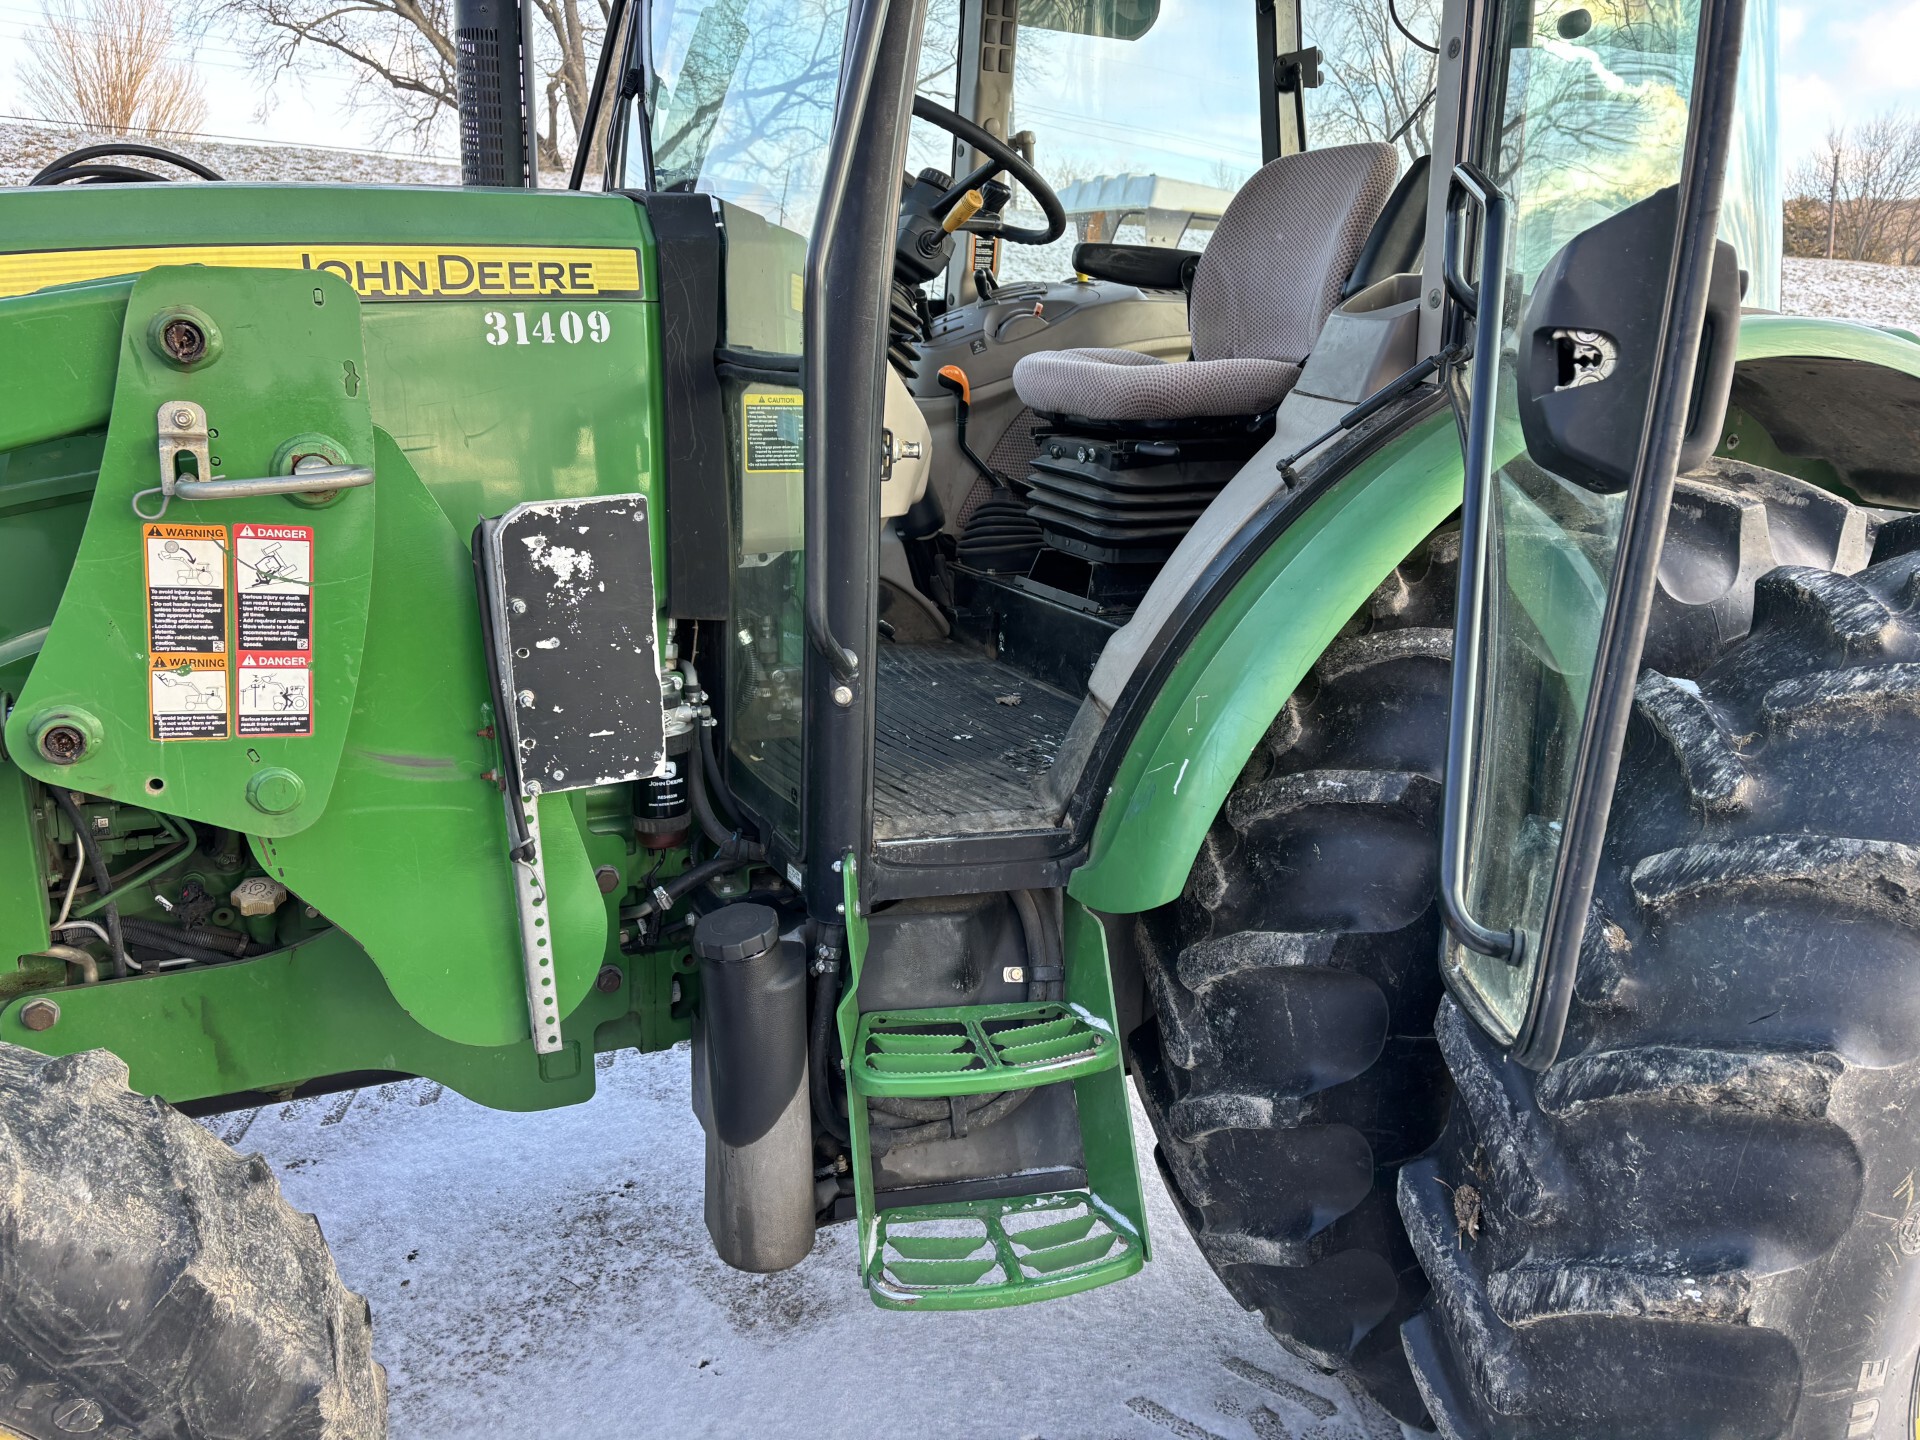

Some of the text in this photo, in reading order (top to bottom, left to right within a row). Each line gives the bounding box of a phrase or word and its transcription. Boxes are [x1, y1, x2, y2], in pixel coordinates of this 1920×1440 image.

[437, 254, 596, 291] DEERE
[485, 310, 612, 346] 31409
[166, 528, 223, 538] WARNING
[258, 528, 307, 538] DANGER
[170, 658, 225, 668] WARNING
[259, 657, 306, 666] DANGER
